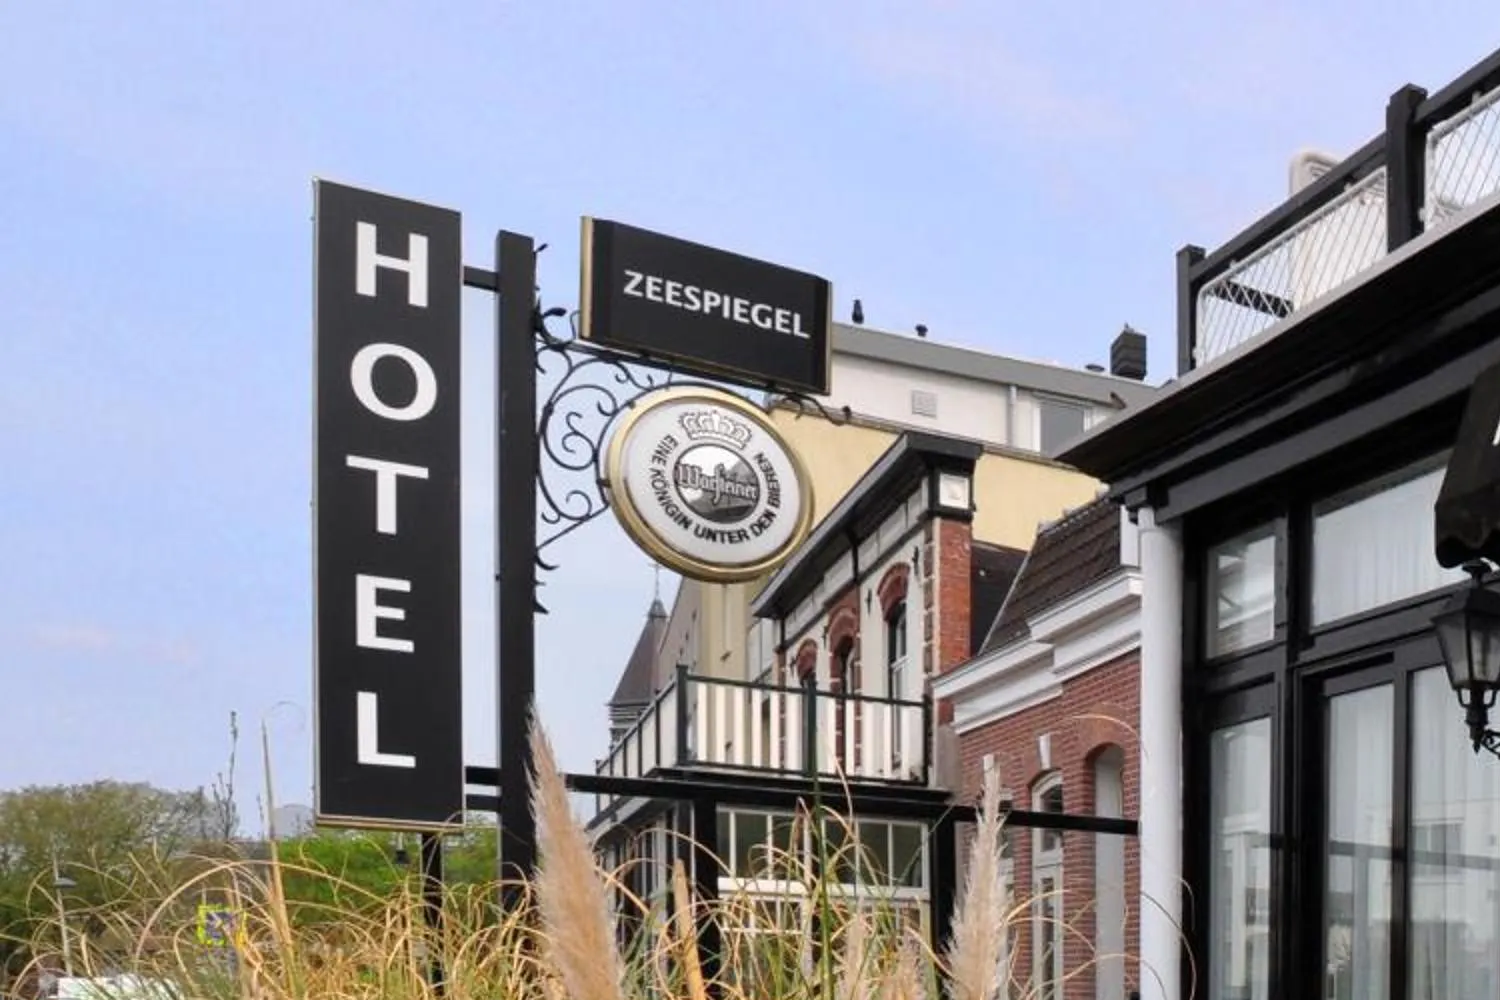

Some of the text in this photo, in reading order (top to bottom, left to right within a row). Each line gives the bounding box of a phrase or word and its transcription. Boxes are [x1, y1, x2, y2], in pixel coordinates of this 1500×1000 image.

[623, 269, 811, 340] ZEESPIEGEL
[651, 434, 680, 467] EINE
[345, 220, 438, 769] HOTEL
[648, 467, 694, 530] KÖNIGIN
[693, 525, 750, 544] UNTER
[750, 510, 777, 538] DEN
